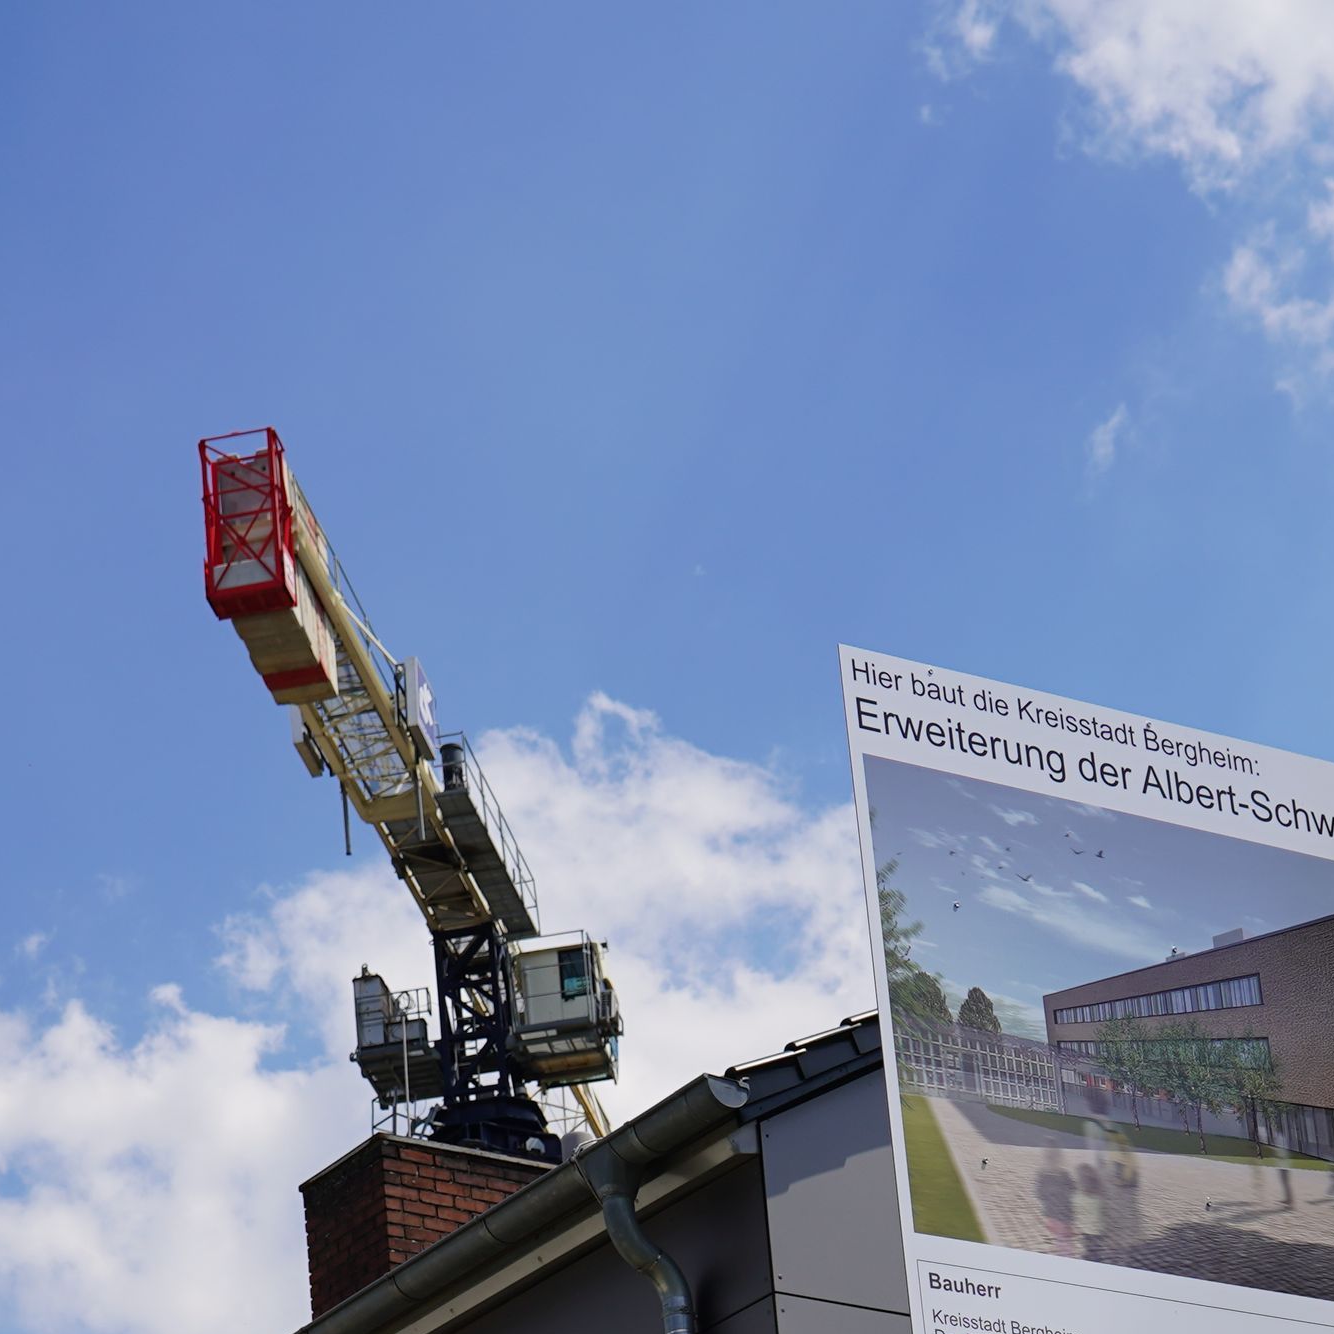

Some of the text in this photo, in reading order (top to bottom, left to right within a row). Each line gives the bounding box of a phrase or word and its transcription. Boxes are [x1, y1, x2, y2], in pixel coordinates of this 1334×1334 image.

[851, 658, 1260, 777] Hier baut die Kreisstadt Bergheim:
[855, 696, 1066, 783] Erweiterung
[1078, 751, 1132, 790] der
[928, 1272, 1002, 1299] Bauherr
[932, 1308, 1007, 1334] Kreisstadt
